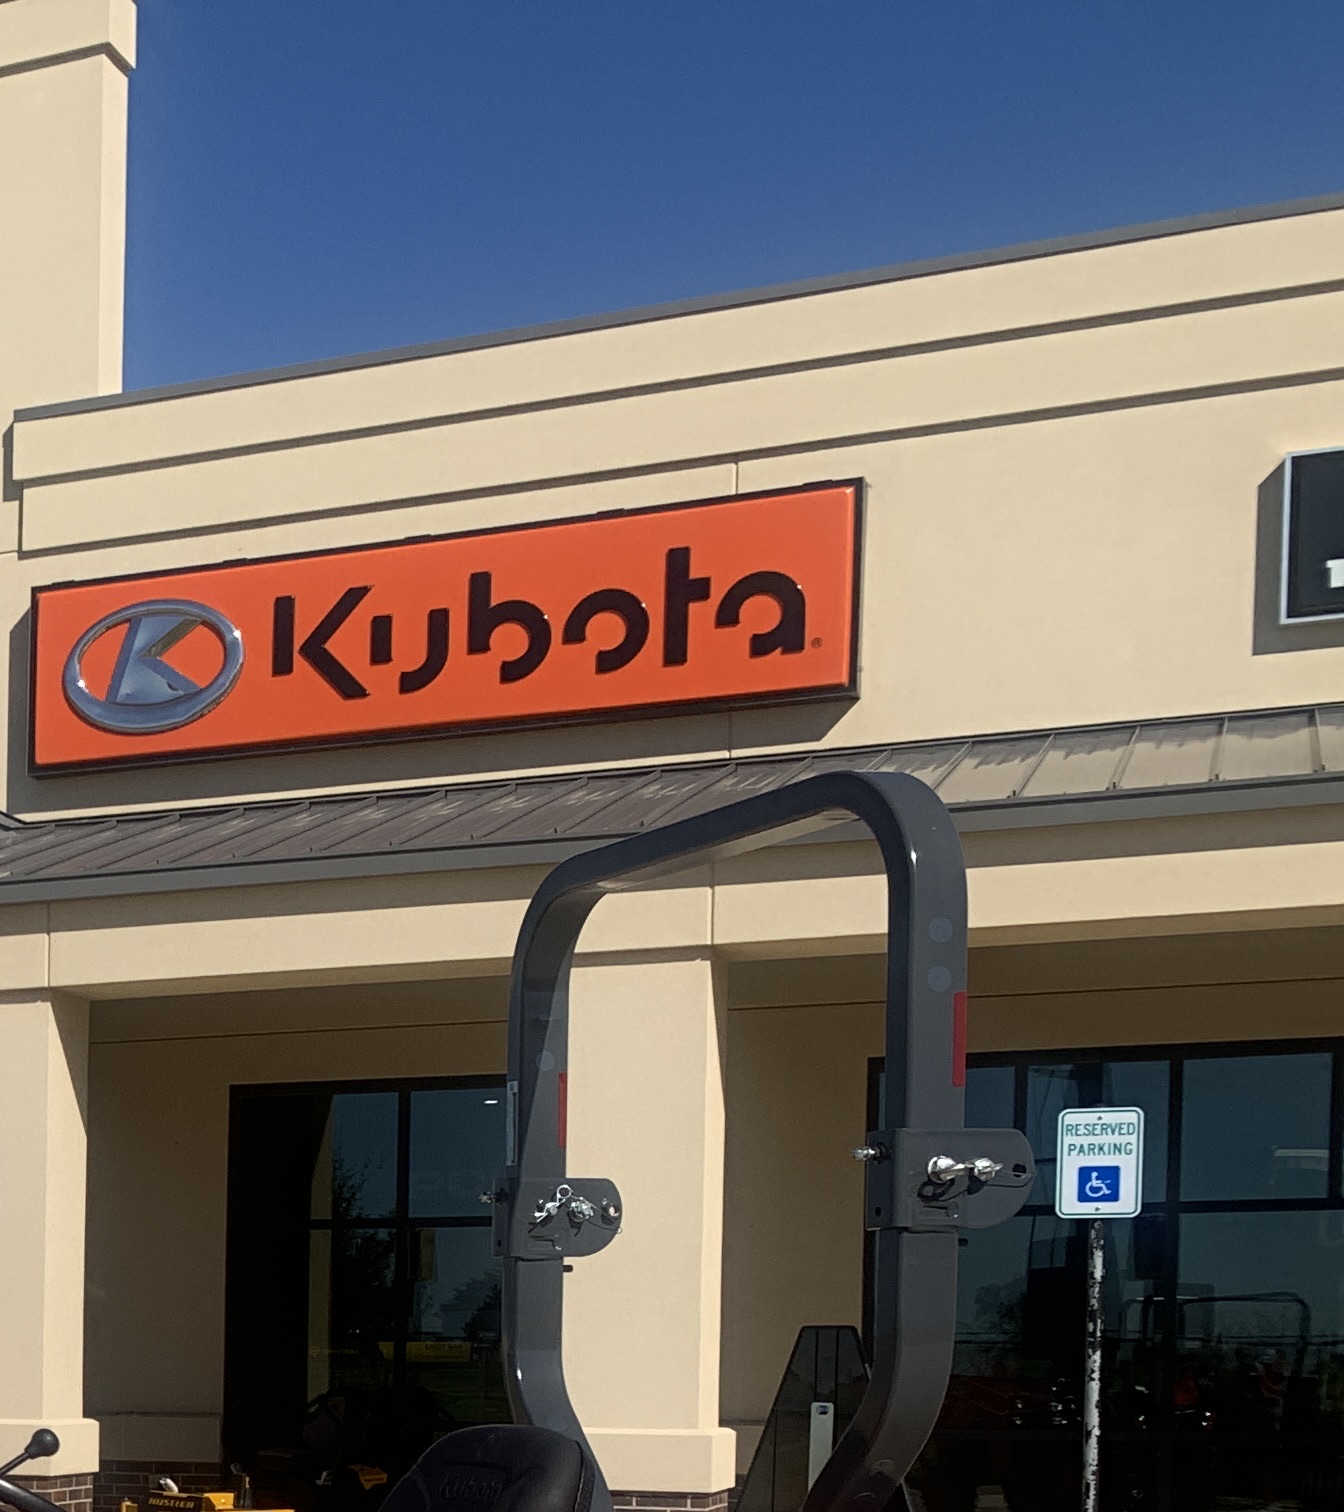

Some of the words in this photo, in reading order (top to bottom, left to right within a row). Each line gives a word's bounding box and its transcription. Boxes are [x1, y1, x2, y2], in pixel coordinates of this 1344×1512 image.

[271, 546, 807, 700] Kubota
[1065, 1122, 1136, 1137] RESERVED
[1067, 1142, 1134, 1157] PARKING
